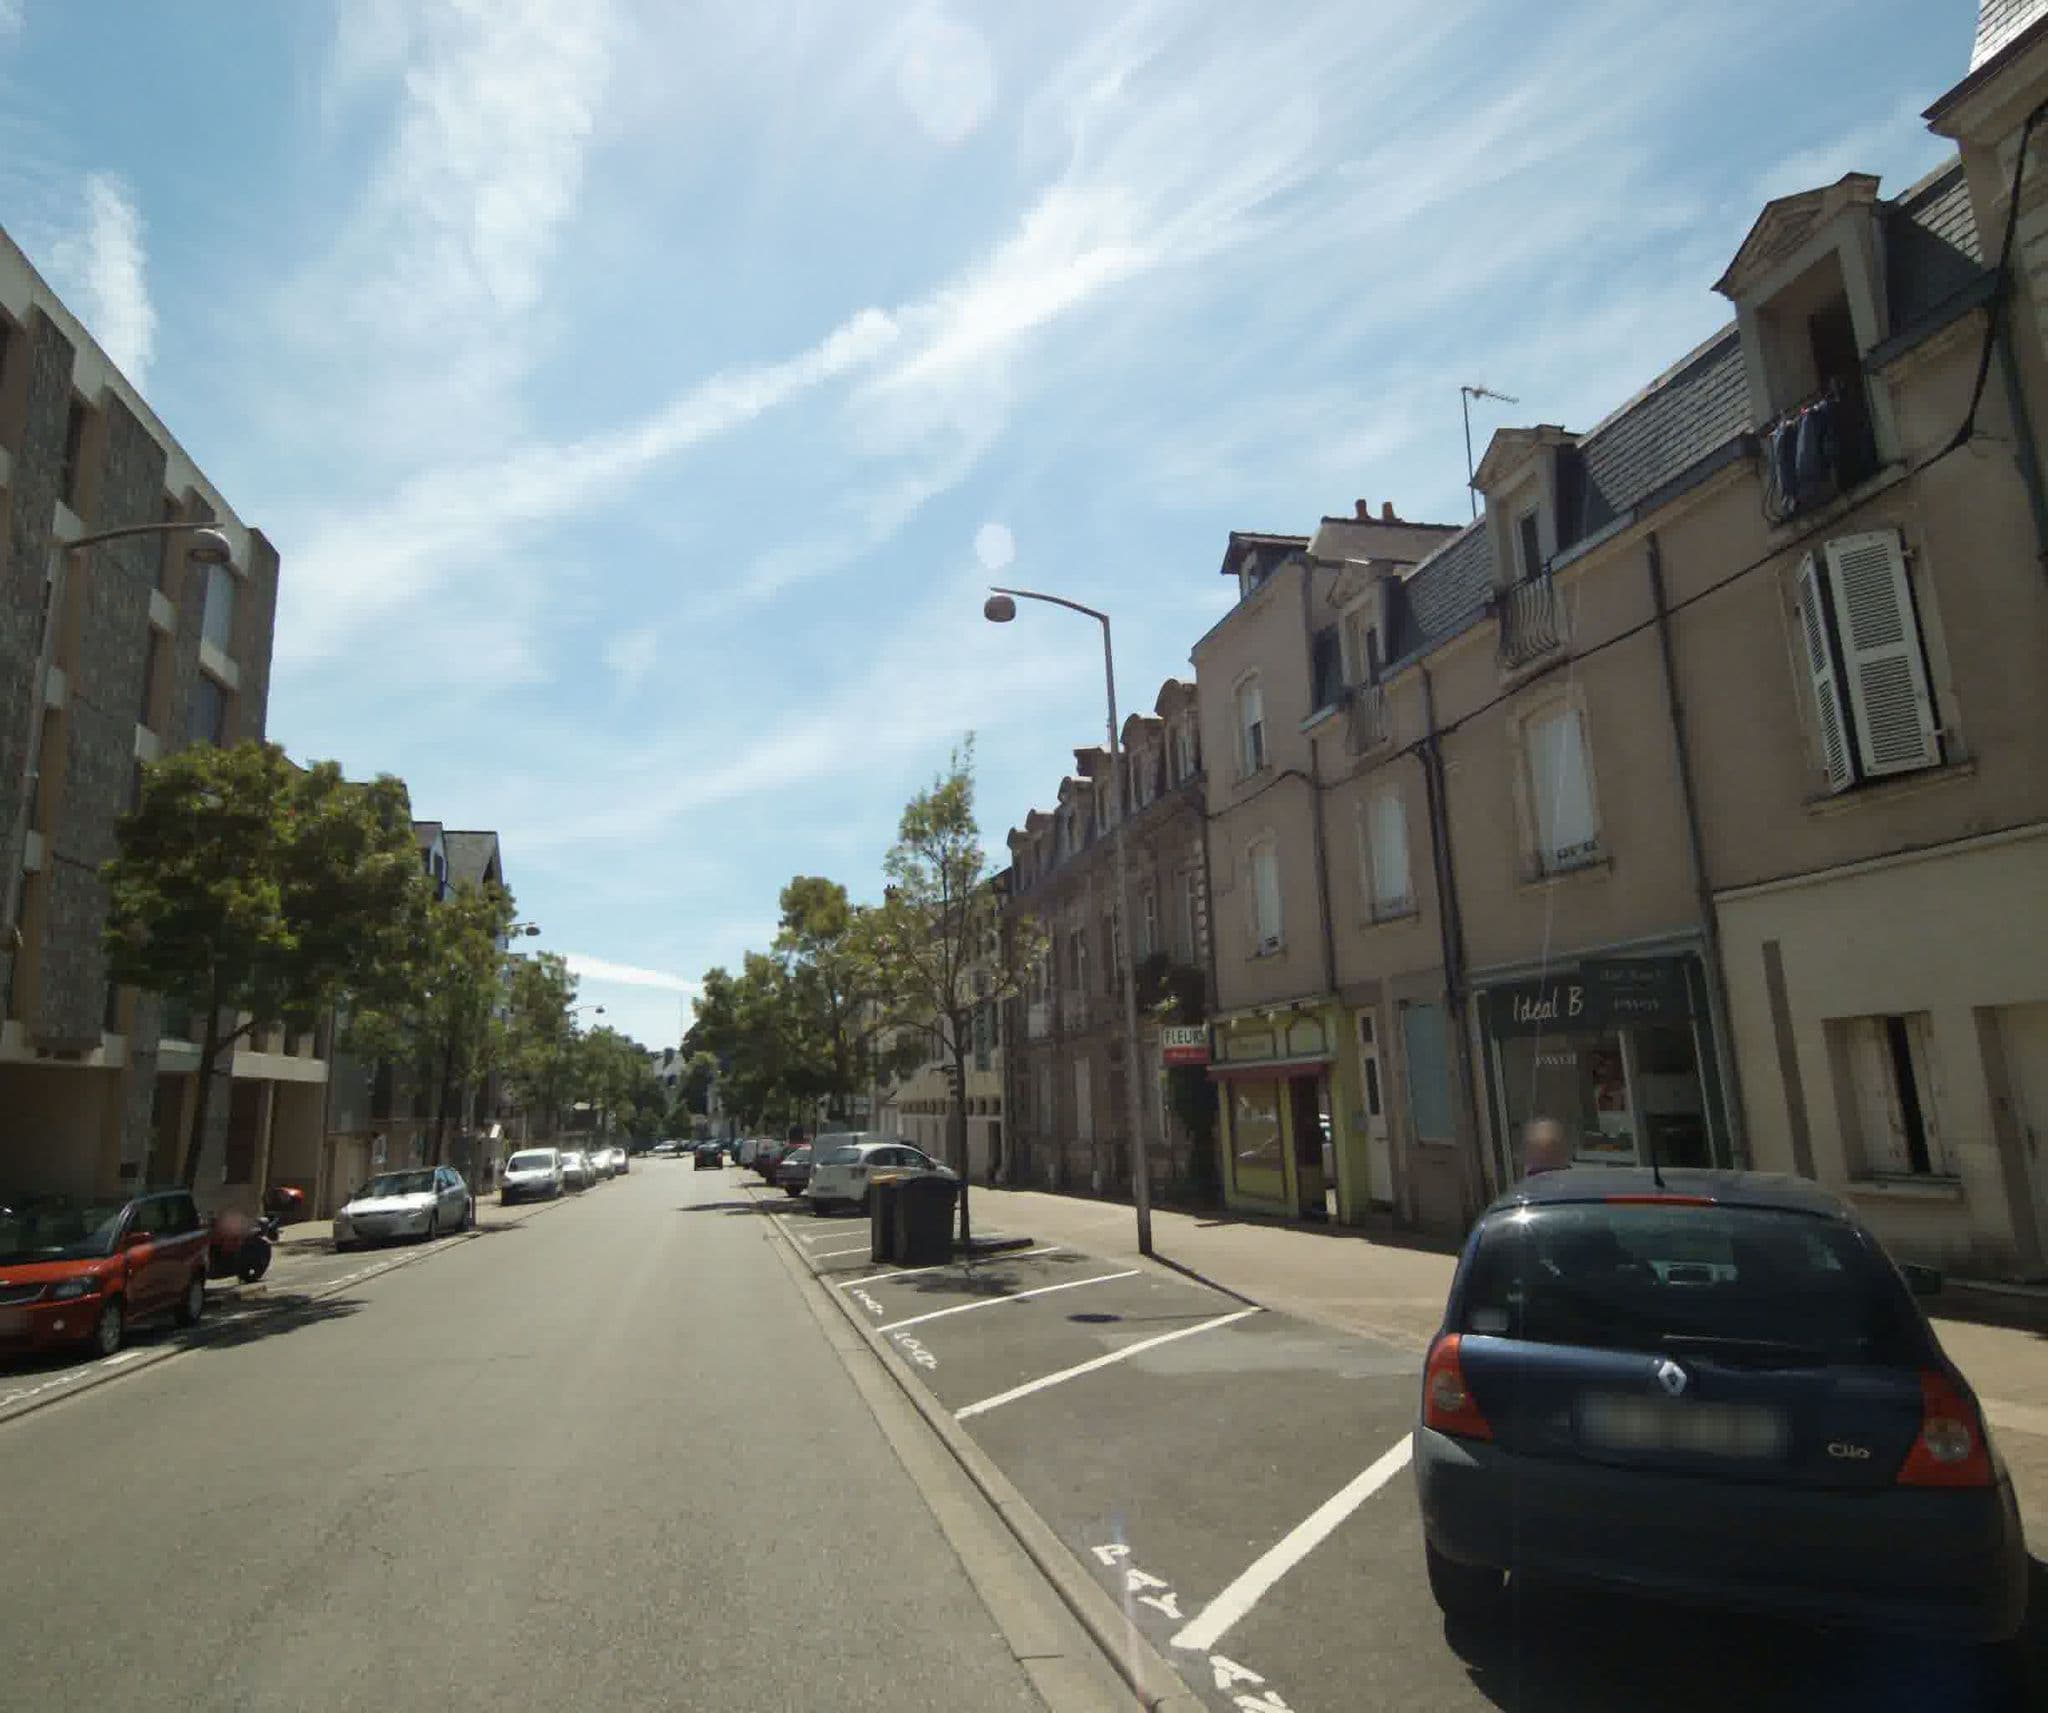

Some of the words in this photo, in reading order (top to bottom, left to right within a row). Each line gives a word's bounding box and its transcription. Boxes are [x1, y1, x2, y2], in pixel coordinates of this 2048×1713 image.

[1513, 988, 1559, 1025] Ideal
[1568, 985, 1586, 1016] B
[1827, 1443, 1871, 1459] Clio
